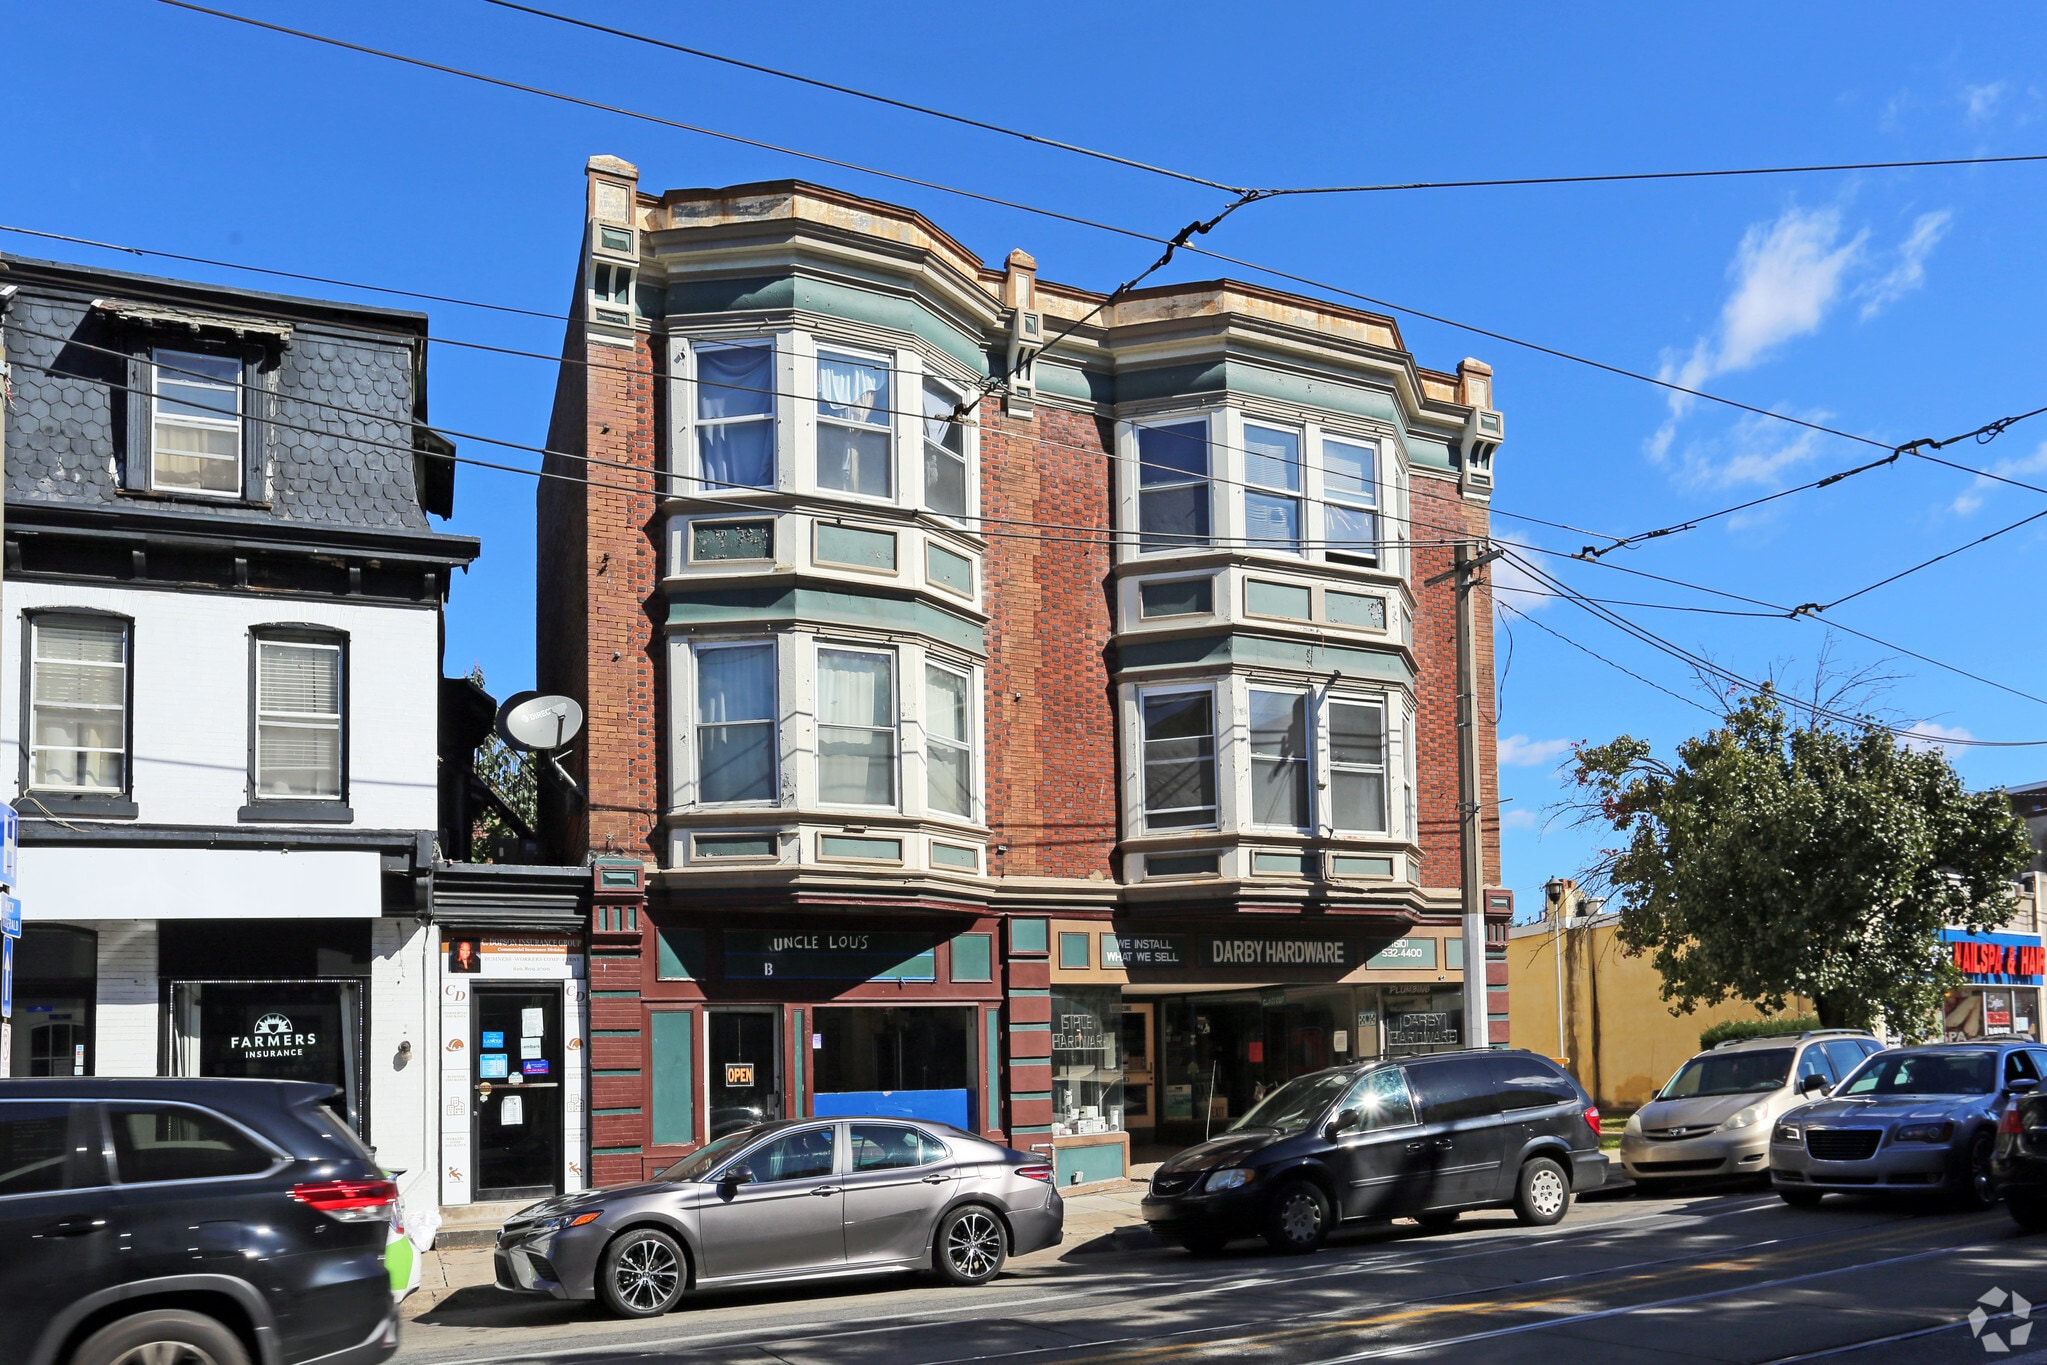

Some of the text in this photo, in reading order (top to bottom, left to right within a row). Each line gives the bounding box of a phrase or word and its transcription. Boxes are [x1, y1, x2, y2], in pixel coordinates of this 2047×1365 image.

[529, 706, 553, 721] DIREC
[3, 814, 15, 878] H
[489, 938, 517, 947] DOPSON
[518, 938, 556, 947] INSURANCE
[557, 938, 582, 947] GROUP
[774, 935, 869, 951] UNCLE LOU'S
[1116, 939, 1173, 949] WE INSTALL
[1106, 951, 1179, 962] WHAT WE SELL
[1212, 940, 1344, 963] DARBY HARDWARE
[1381, 948, 1422, 958] 532-4400
[2007, 946, 2016, 975] &
[2020, 945, 2046, 976] HAIR
[764, 962, 773, 976] B
[1389, 984, 1431, 995] PLUMBING
[1403, 1014, 1445, 1027] DARBY
[231, 1033, 316, 1049] FARMERS
[1389, 1031, 1458, 1043] HARDWARE
[245, 1049, 303, 1058] INSURANCE
[728, 1068, 752, 1083] OPEN
